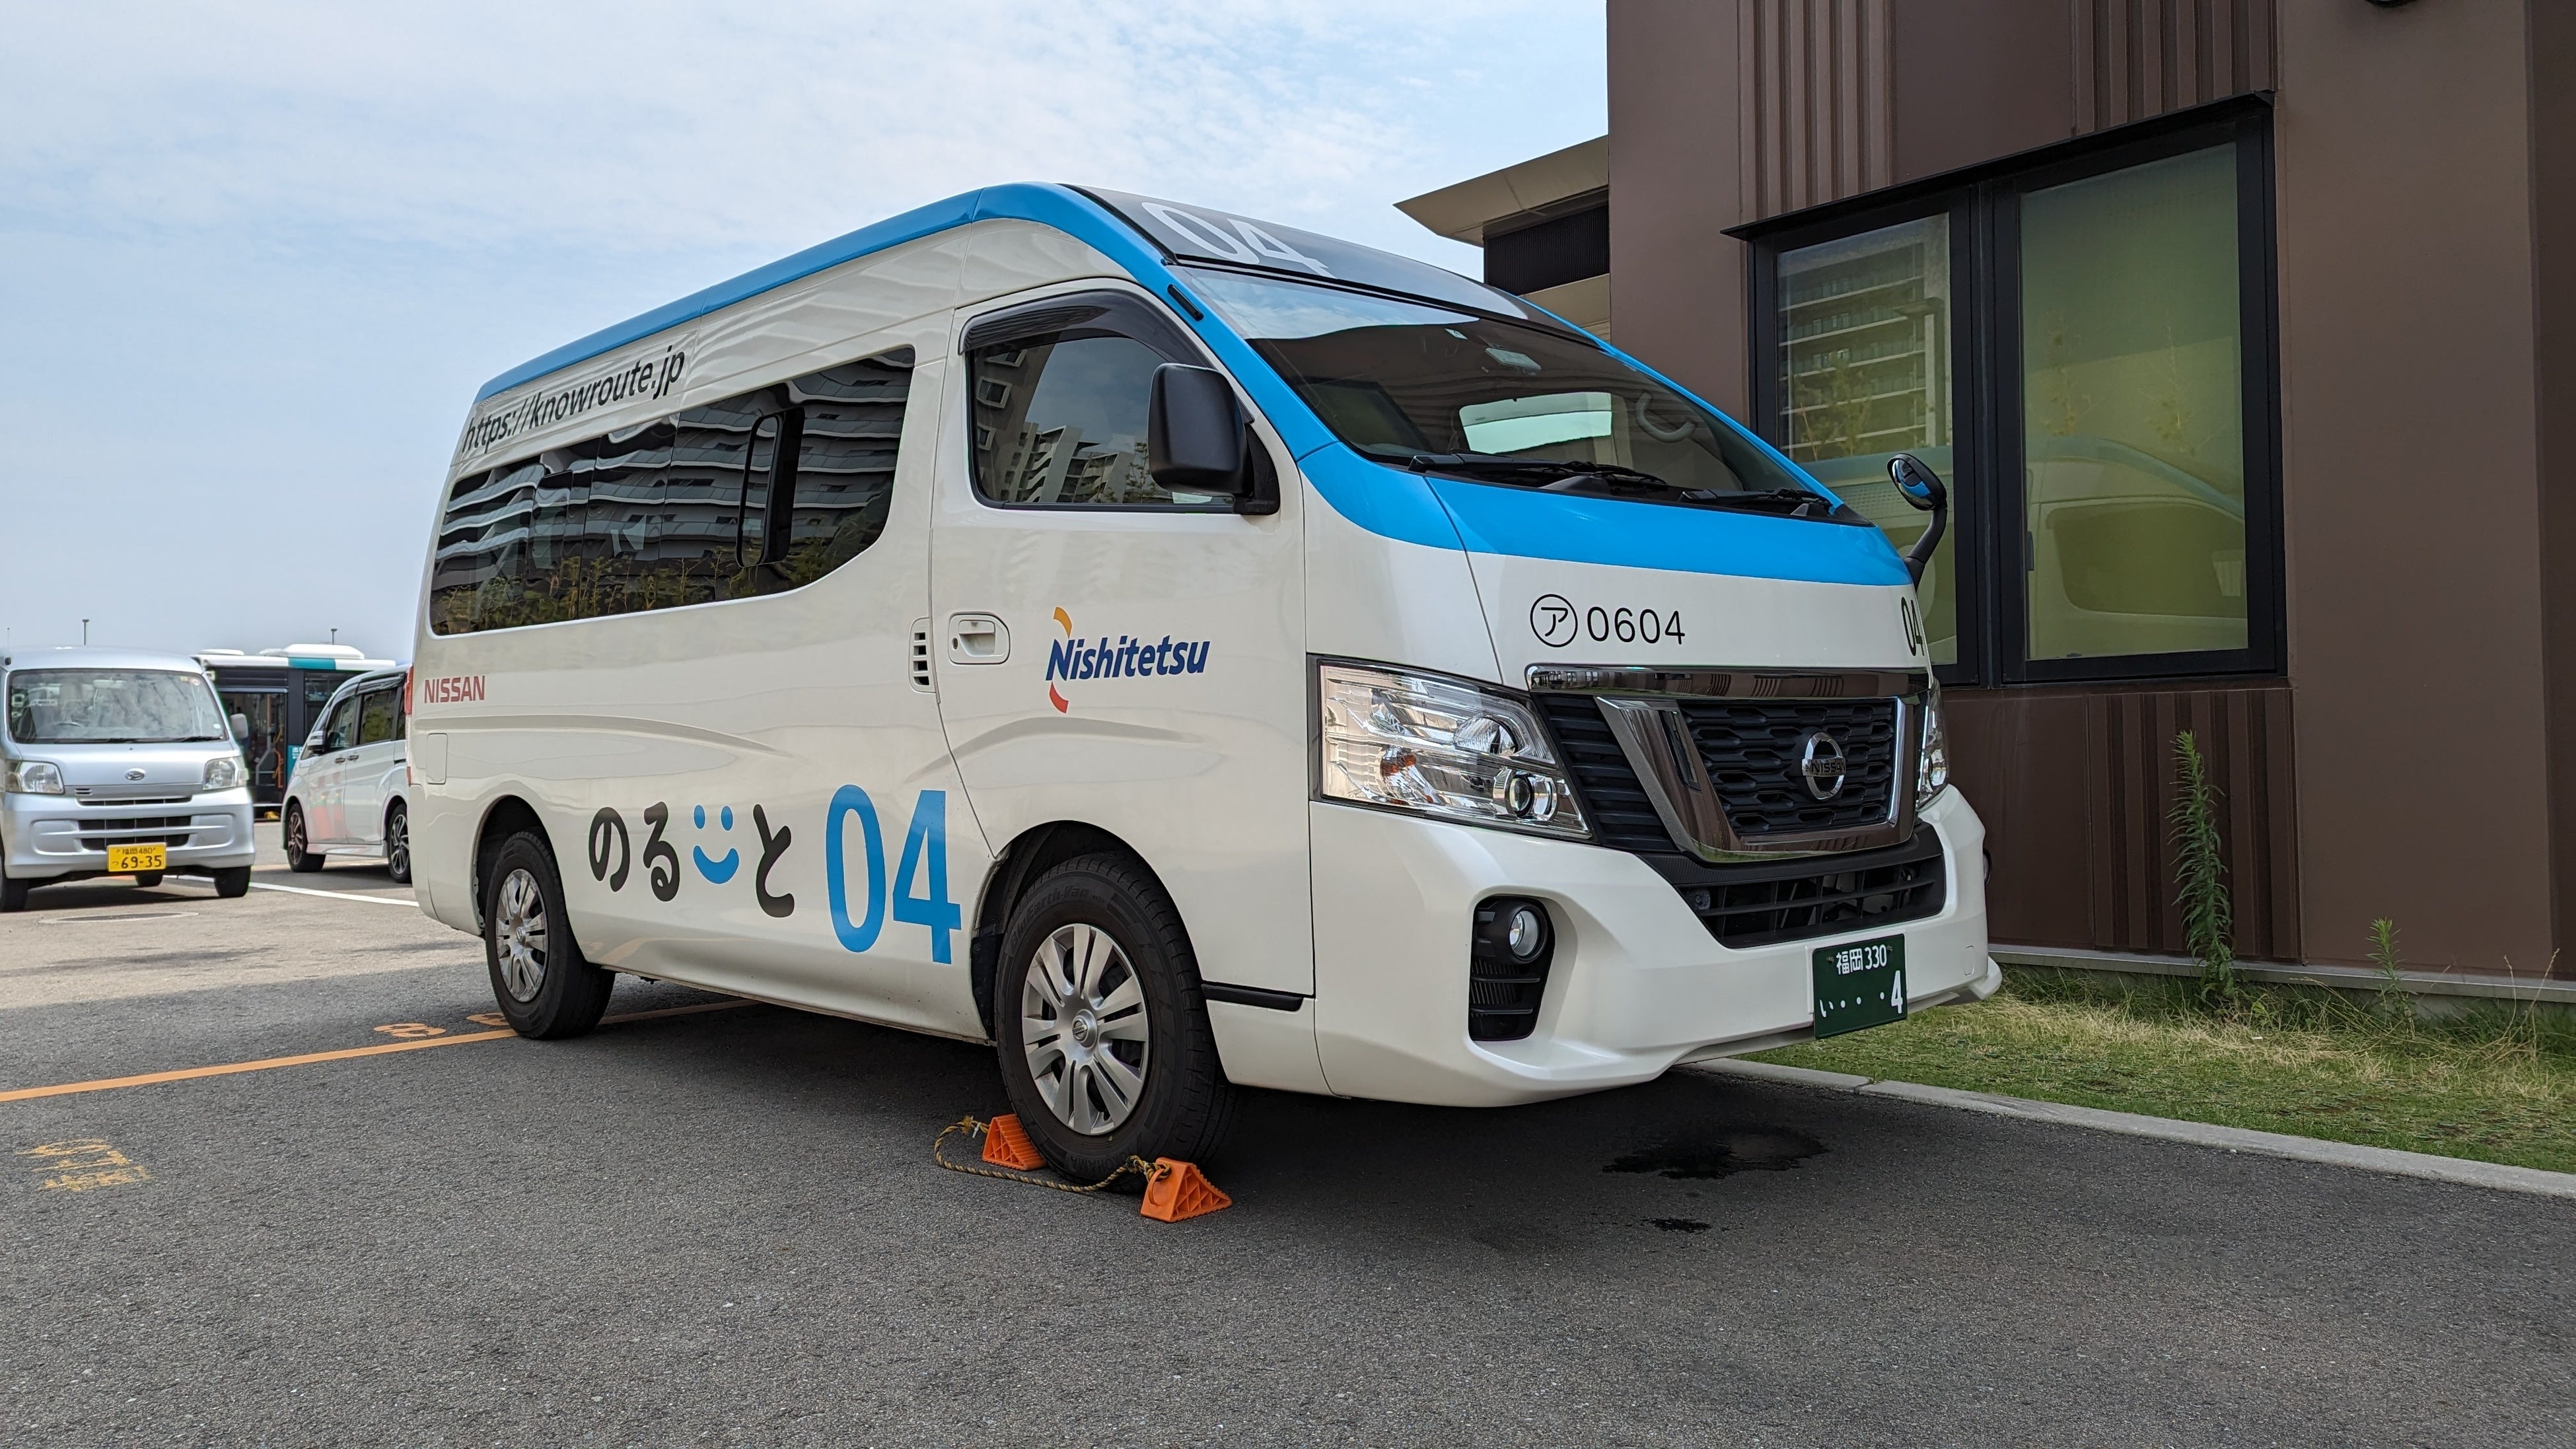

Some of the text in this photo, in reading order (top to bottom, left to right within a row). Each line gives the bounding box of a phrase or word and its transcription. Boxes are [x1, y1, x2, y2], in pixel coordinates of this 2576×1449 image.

[1141, 201, 1338, 279] 04
[462, 345, 685, 454] https://knowroute.jp
[1588, 607, 1686, 645] 0604
[1901, 596, 1925, 656] 04
[1045, 635, 1211, 682] Nishitetsu
[424, 675, 485, 703] NISSAN
[121, 855, 162, 869] 69-35
[826, 784, 962, 964] 04
[1836, 944, 1888, 975] 福岡 330
